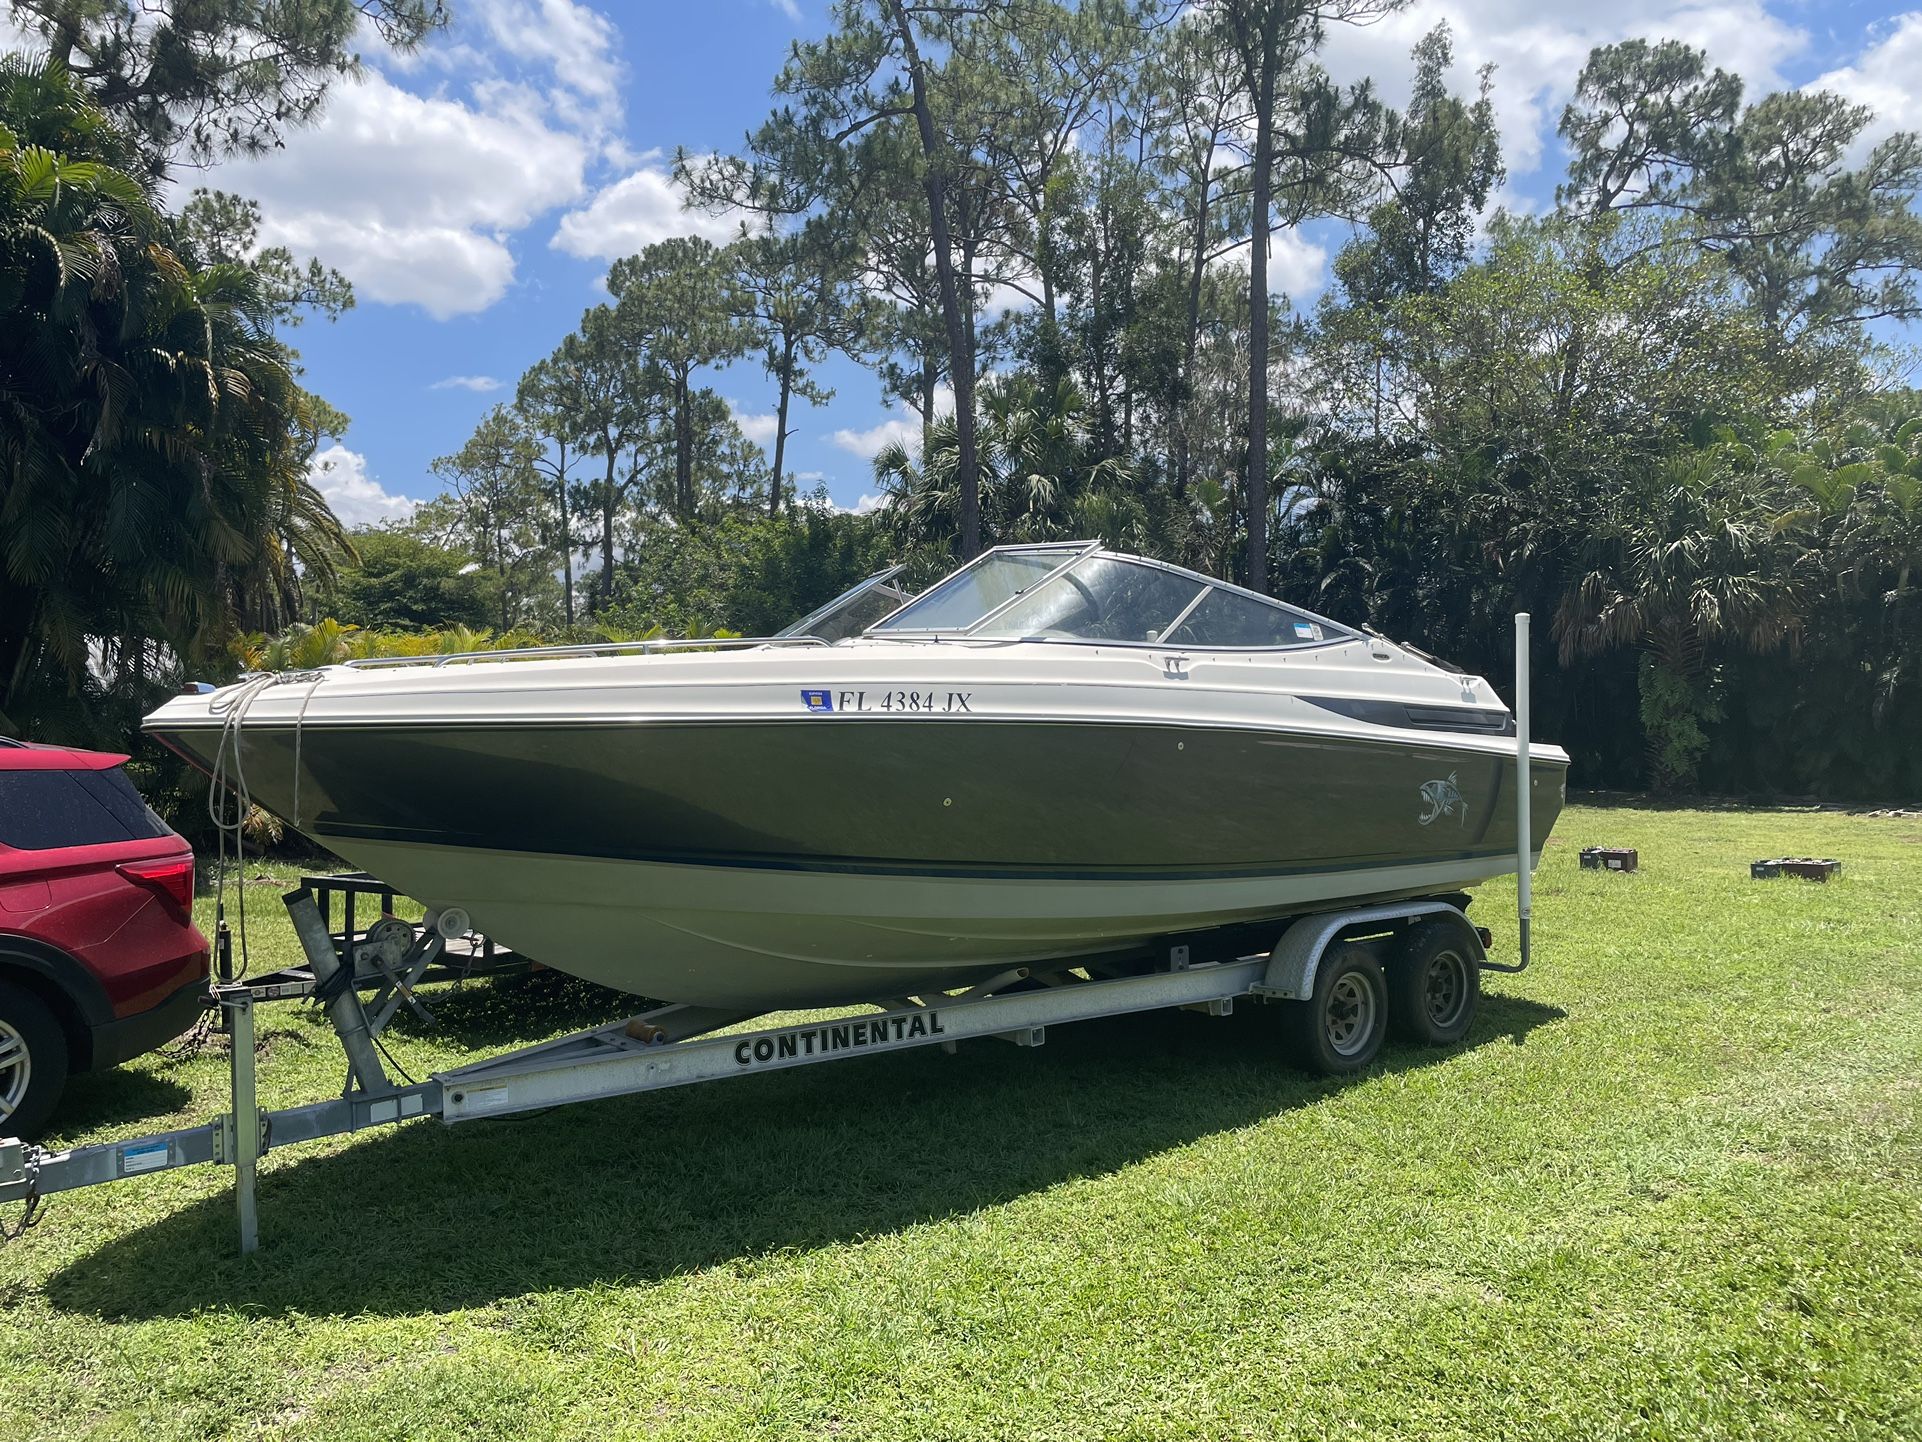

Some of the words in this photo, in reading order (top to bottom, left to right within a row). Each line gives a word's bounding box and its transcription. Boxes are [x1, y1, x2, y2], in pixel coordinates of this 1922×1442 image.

[838, 691, 872, 711] FL
[880, 691, 934, 712] 4384
[942, 692, 973, 712] JX
[734, 1011, 945, 1065] CONTINENTAL
